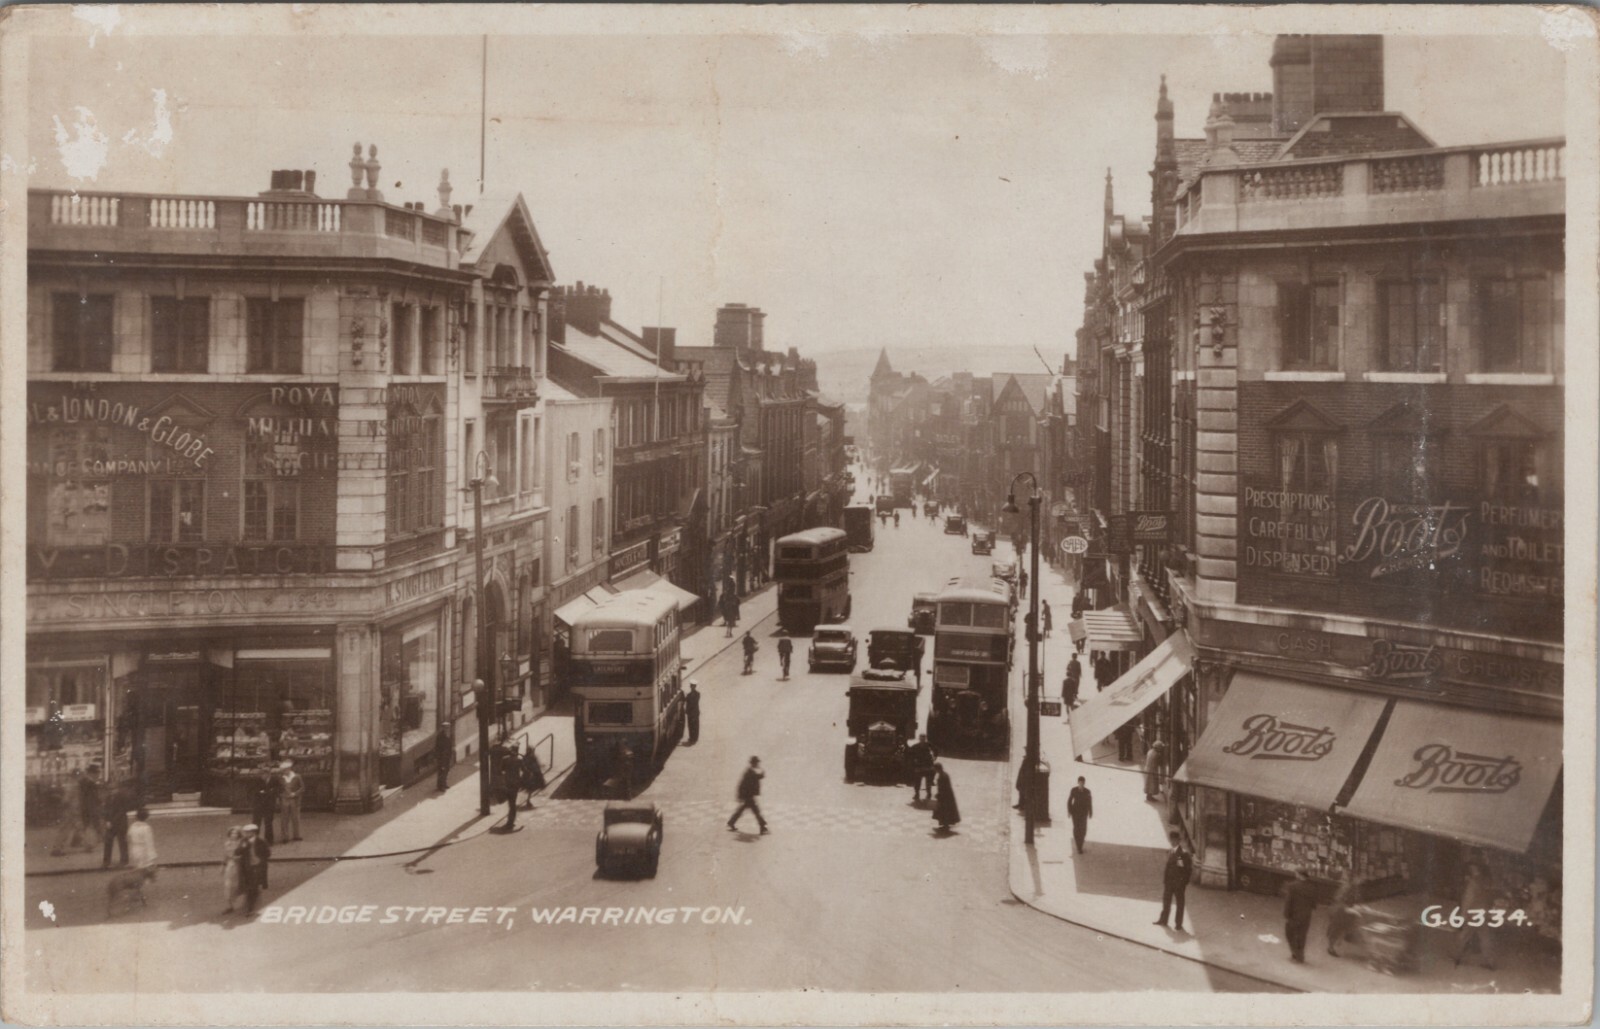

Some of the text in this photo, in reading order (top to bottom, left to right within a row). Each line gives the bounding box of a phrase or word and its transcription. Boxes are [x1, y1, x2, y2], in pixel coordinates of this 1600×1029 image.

[62, 395, 140, 427] LONDON
[137, 417, 150, 431] &
[151, 415, 214, 468] GLOBE
[82, 458, 161, 474] COMPANY
[1245, 487, 1330, 511] PRESCRIPTIONS
[1250, 517, 1329, 542] CAREFULLY
[1481, 501, 1562, 530] PERFUMER
[1337, 497, 1472, 578] Boots
[1506, 536, 1563, 564] TOILET
[1246, 546, 1330, 572] DISPENSED
[66, 590, 250, 617] SINGLETON
[1277, 633, 1560, 684] CASH Boots CHEMISTS
[1222, 713, 1337, 762] Boots
[1393, 743, 1524, 794] Boots
